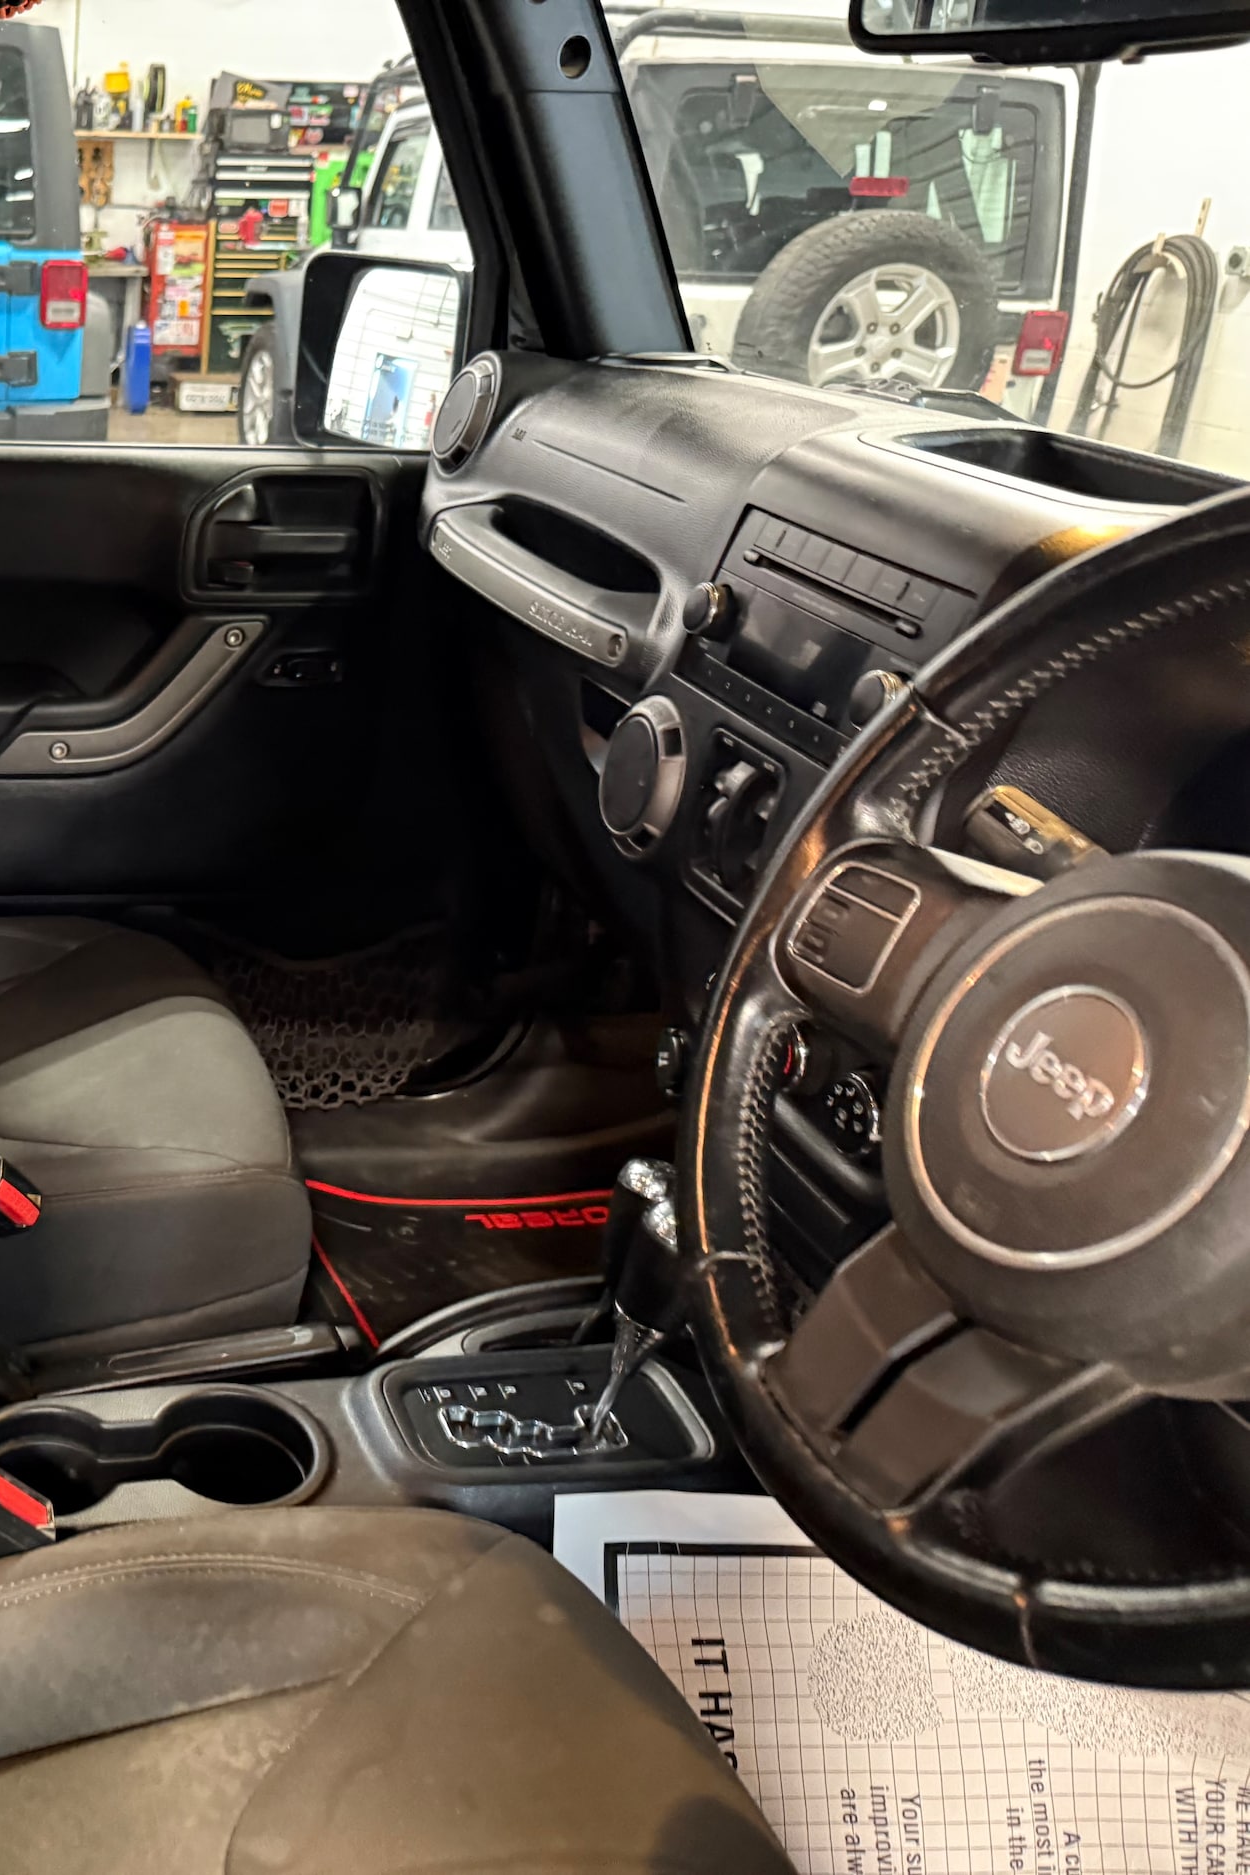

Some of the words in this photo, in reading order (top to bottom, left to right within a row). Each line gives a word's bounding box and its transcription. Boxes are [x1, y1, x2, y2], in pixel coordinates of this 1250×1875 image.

[1006, 1030, 1115, 1120] Jeep
[691, 1638, 729, 1674] IT
[1028, 1758, 1046, 1793] the
[840, 1788, 858, 1824] are
[901, 1794, 922, 1846] Your
[1006, 1806, 1024, 1827] in
[1175, 1787, 1199, 1844] WITH
[1205, 1778, 1227, 1835] YOUR
[1033, 1803, 1054, 1858] most
[1063, 1831, 1081, 1847] A
[1008, 1835, 1027, 1870] the
